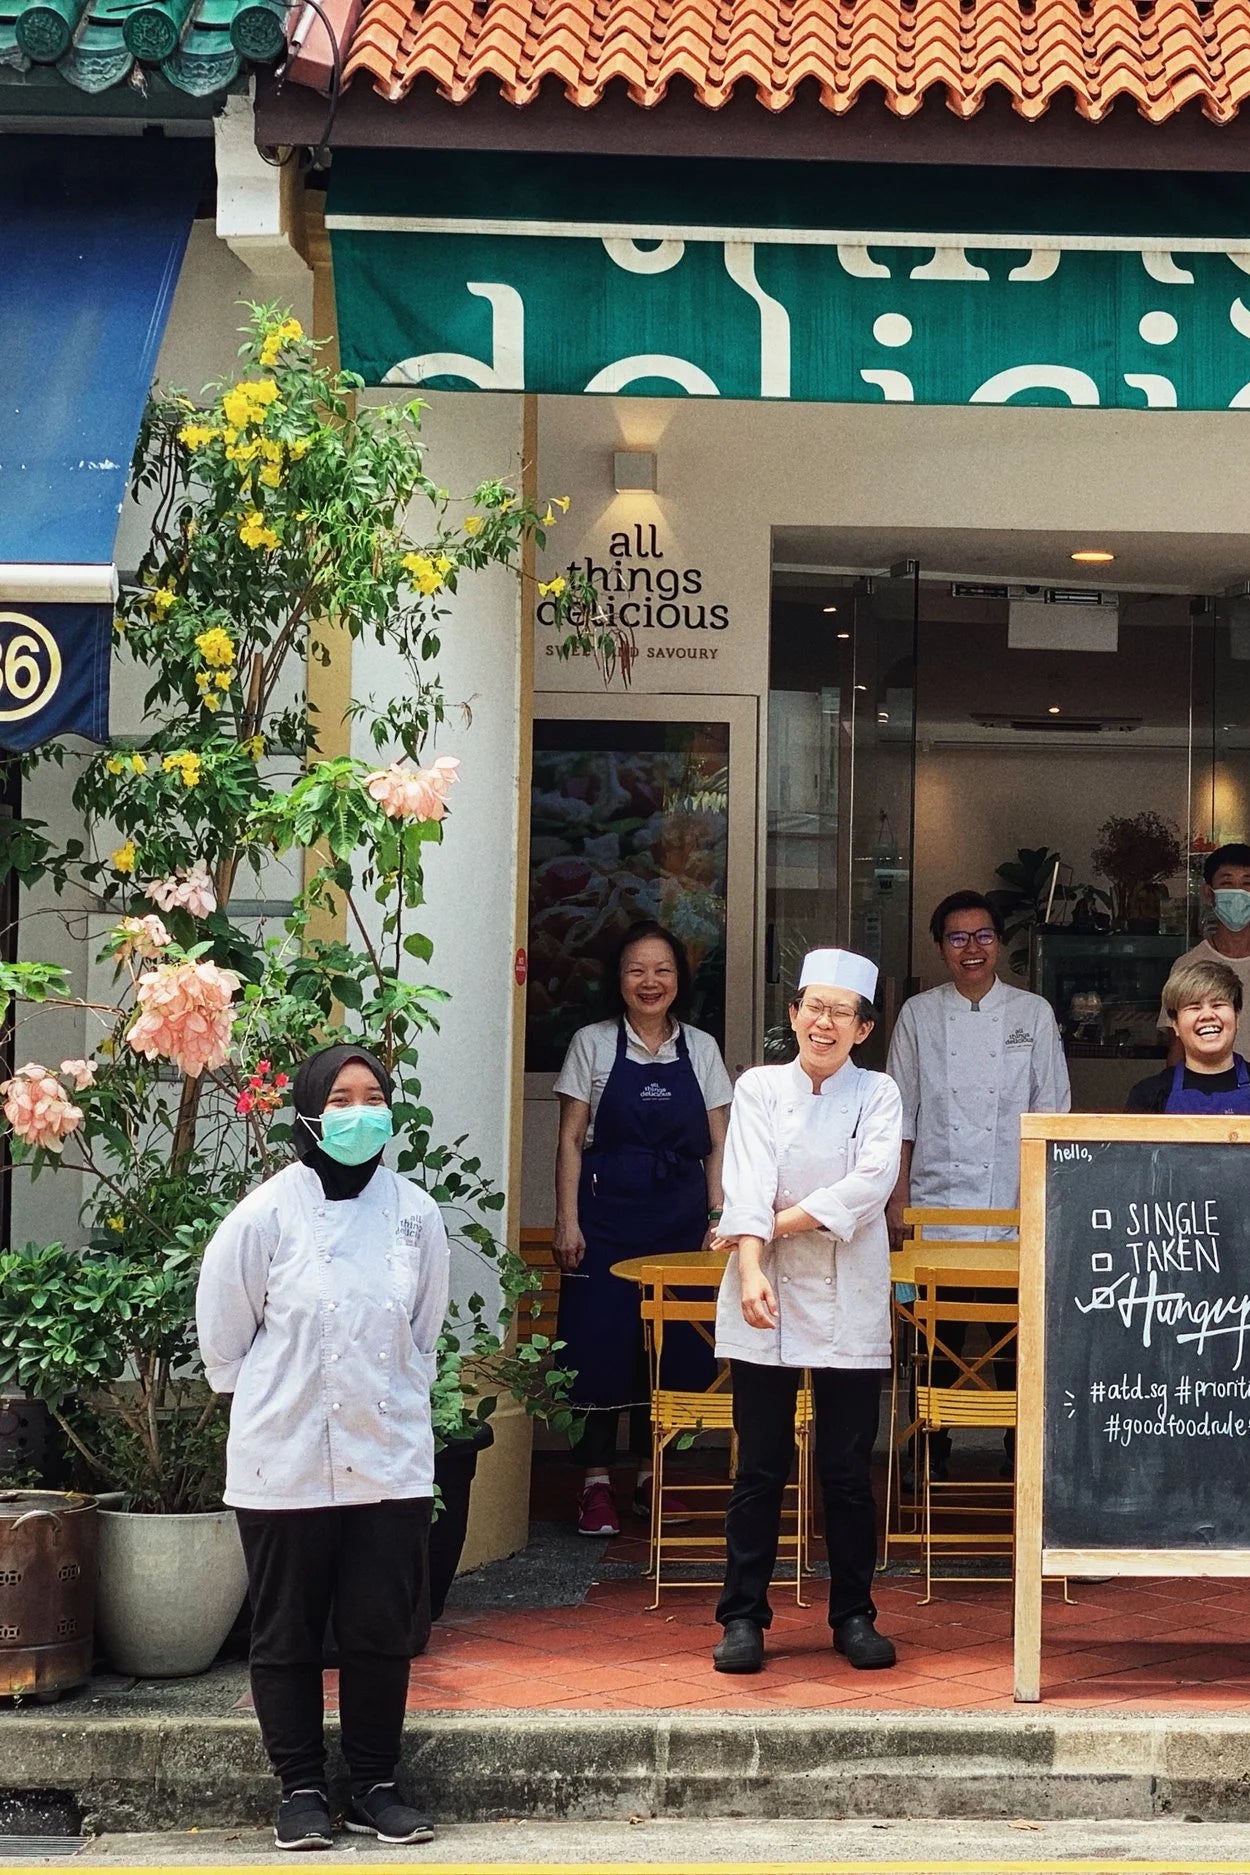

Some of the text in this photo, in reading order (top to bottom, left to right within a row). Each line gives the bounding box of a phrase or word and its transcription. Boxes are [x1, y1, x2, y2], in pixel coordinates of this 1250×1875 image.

[609, 523, 664, 559] all
[566, 557, 702, 601] things
[647, 647, 719, 660] SAVOURY
[1053, 1143, 1093, 1162] hello,
[1126, 1200, 1220, 1236] SINGLE
[1126, 1235, 1220, 1274] TAKEN
